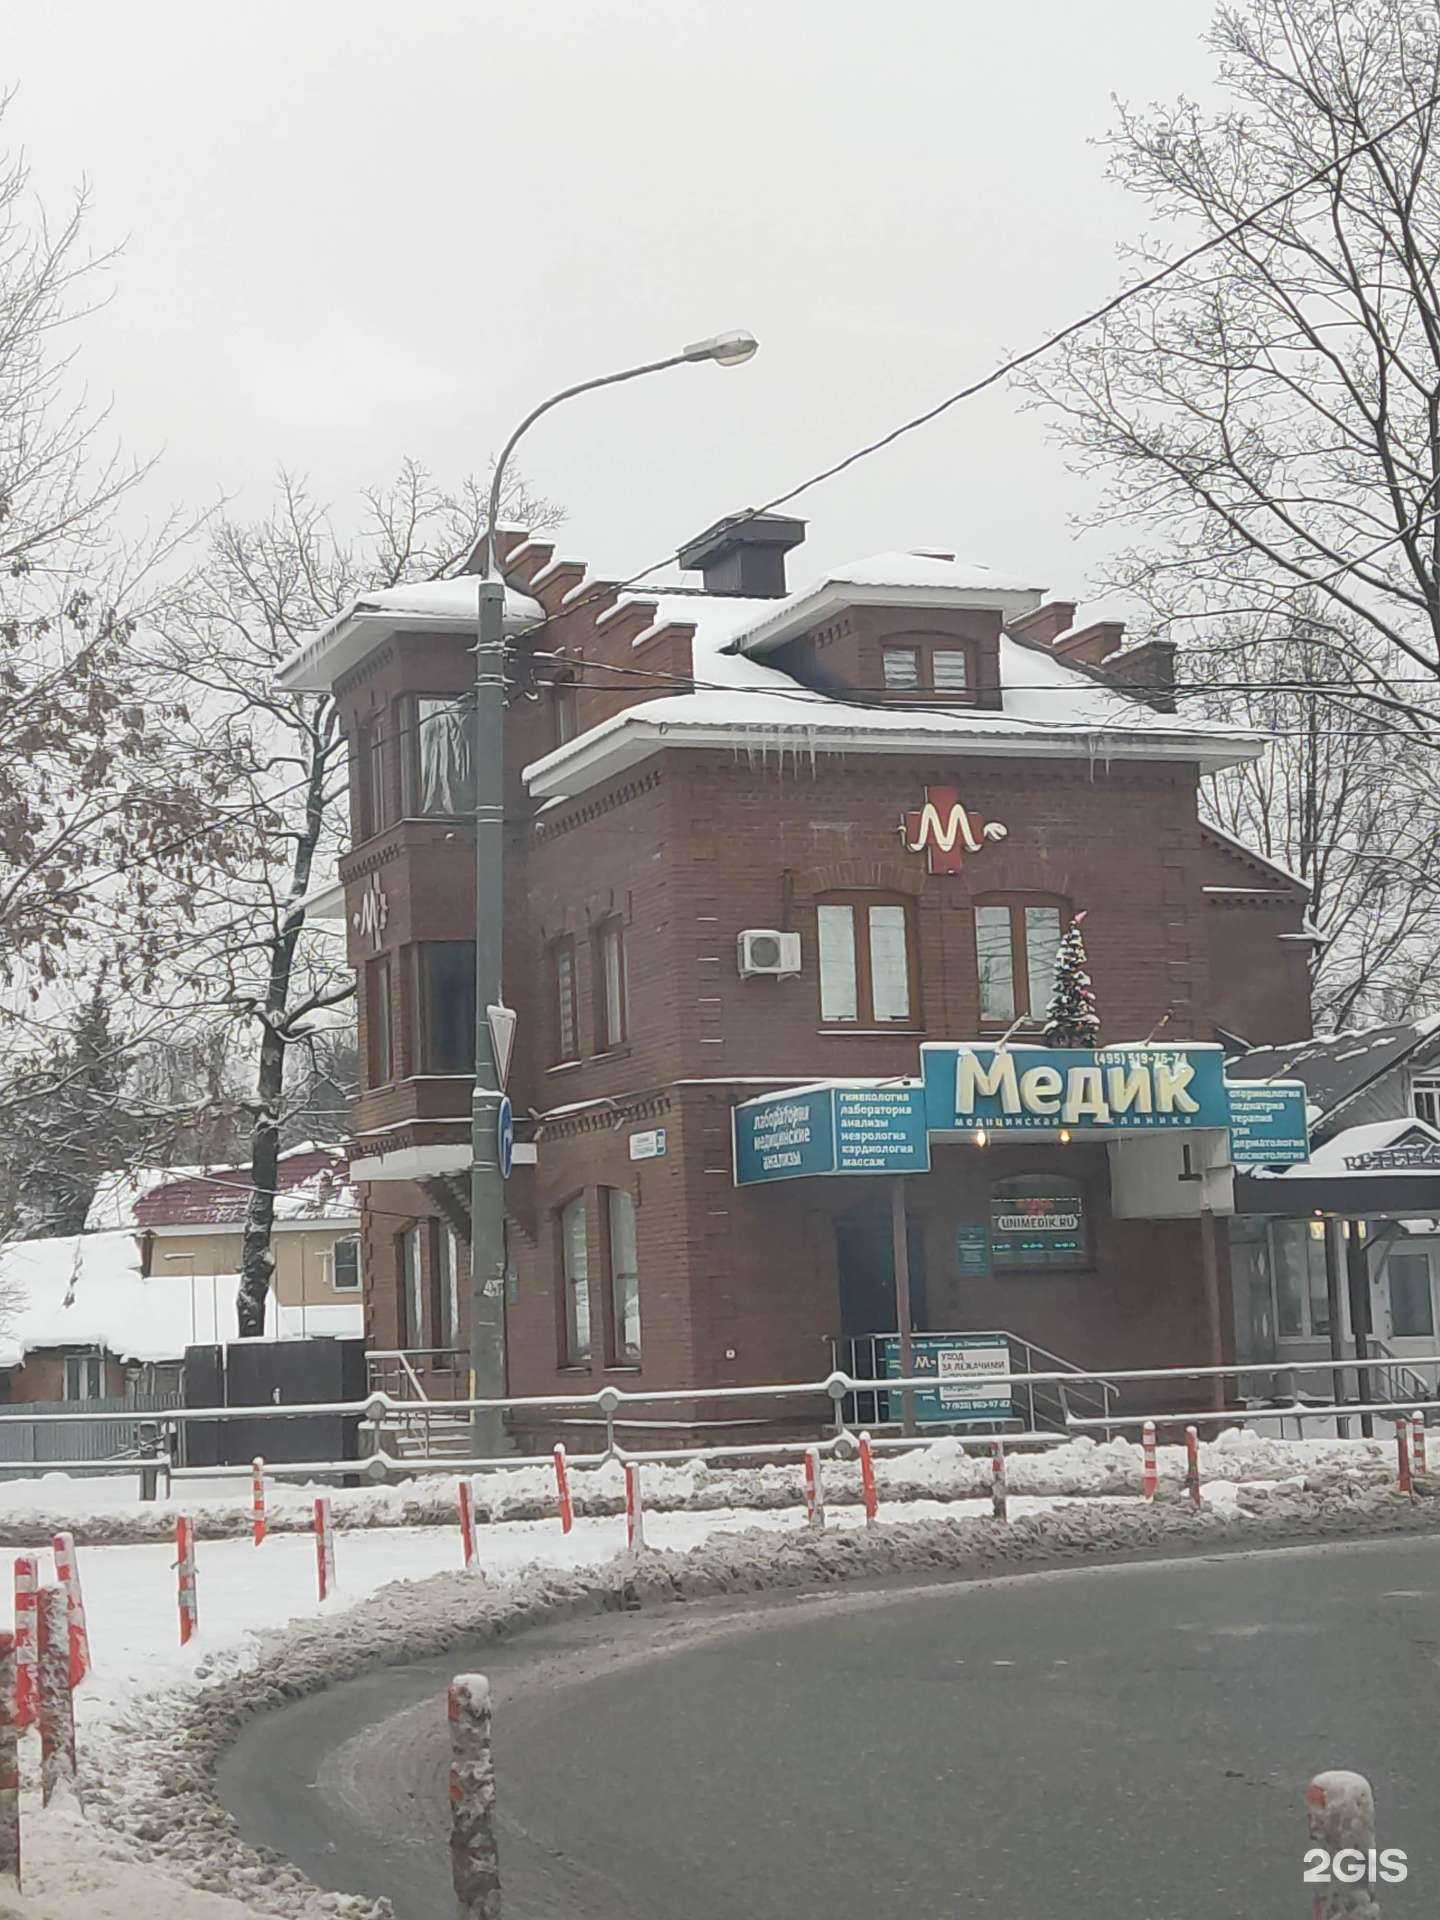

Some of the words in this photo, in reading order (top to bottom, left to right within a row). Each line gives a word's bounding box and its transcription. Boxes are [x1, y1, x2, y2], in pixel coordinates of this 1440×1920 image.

[1094, 1052, 1126, 1065] (495)
[955, 1048, 1200, 1123] Медик
[839, 1093, 910, 1102] гинекология
[840, 1103, 912, 1117] лаборатория
[1230, 1102, 1284, 1113] педиатрия
[840, 1119, 889, 1128] анализы
[954, 1117, 1061, 1127] медицинская
[1230, 1114, 1273, 1125] терапия
[841, 1131, 907, 1142] неврология
[1232, 1139, 1305, 1149] дерматология
[841, 1144, 914, 1156] кардиология
[1233, 1151, 1305, 1160] косметология
[762, 1150, 802, 1170] анализы
[842, 1158, 886, 1167] массаж
[1001, 1215, 1075, 1229] UNIMEDIK.RU
[954, 1360, 1005, 1371] ЛЕЖАЧИМИ
